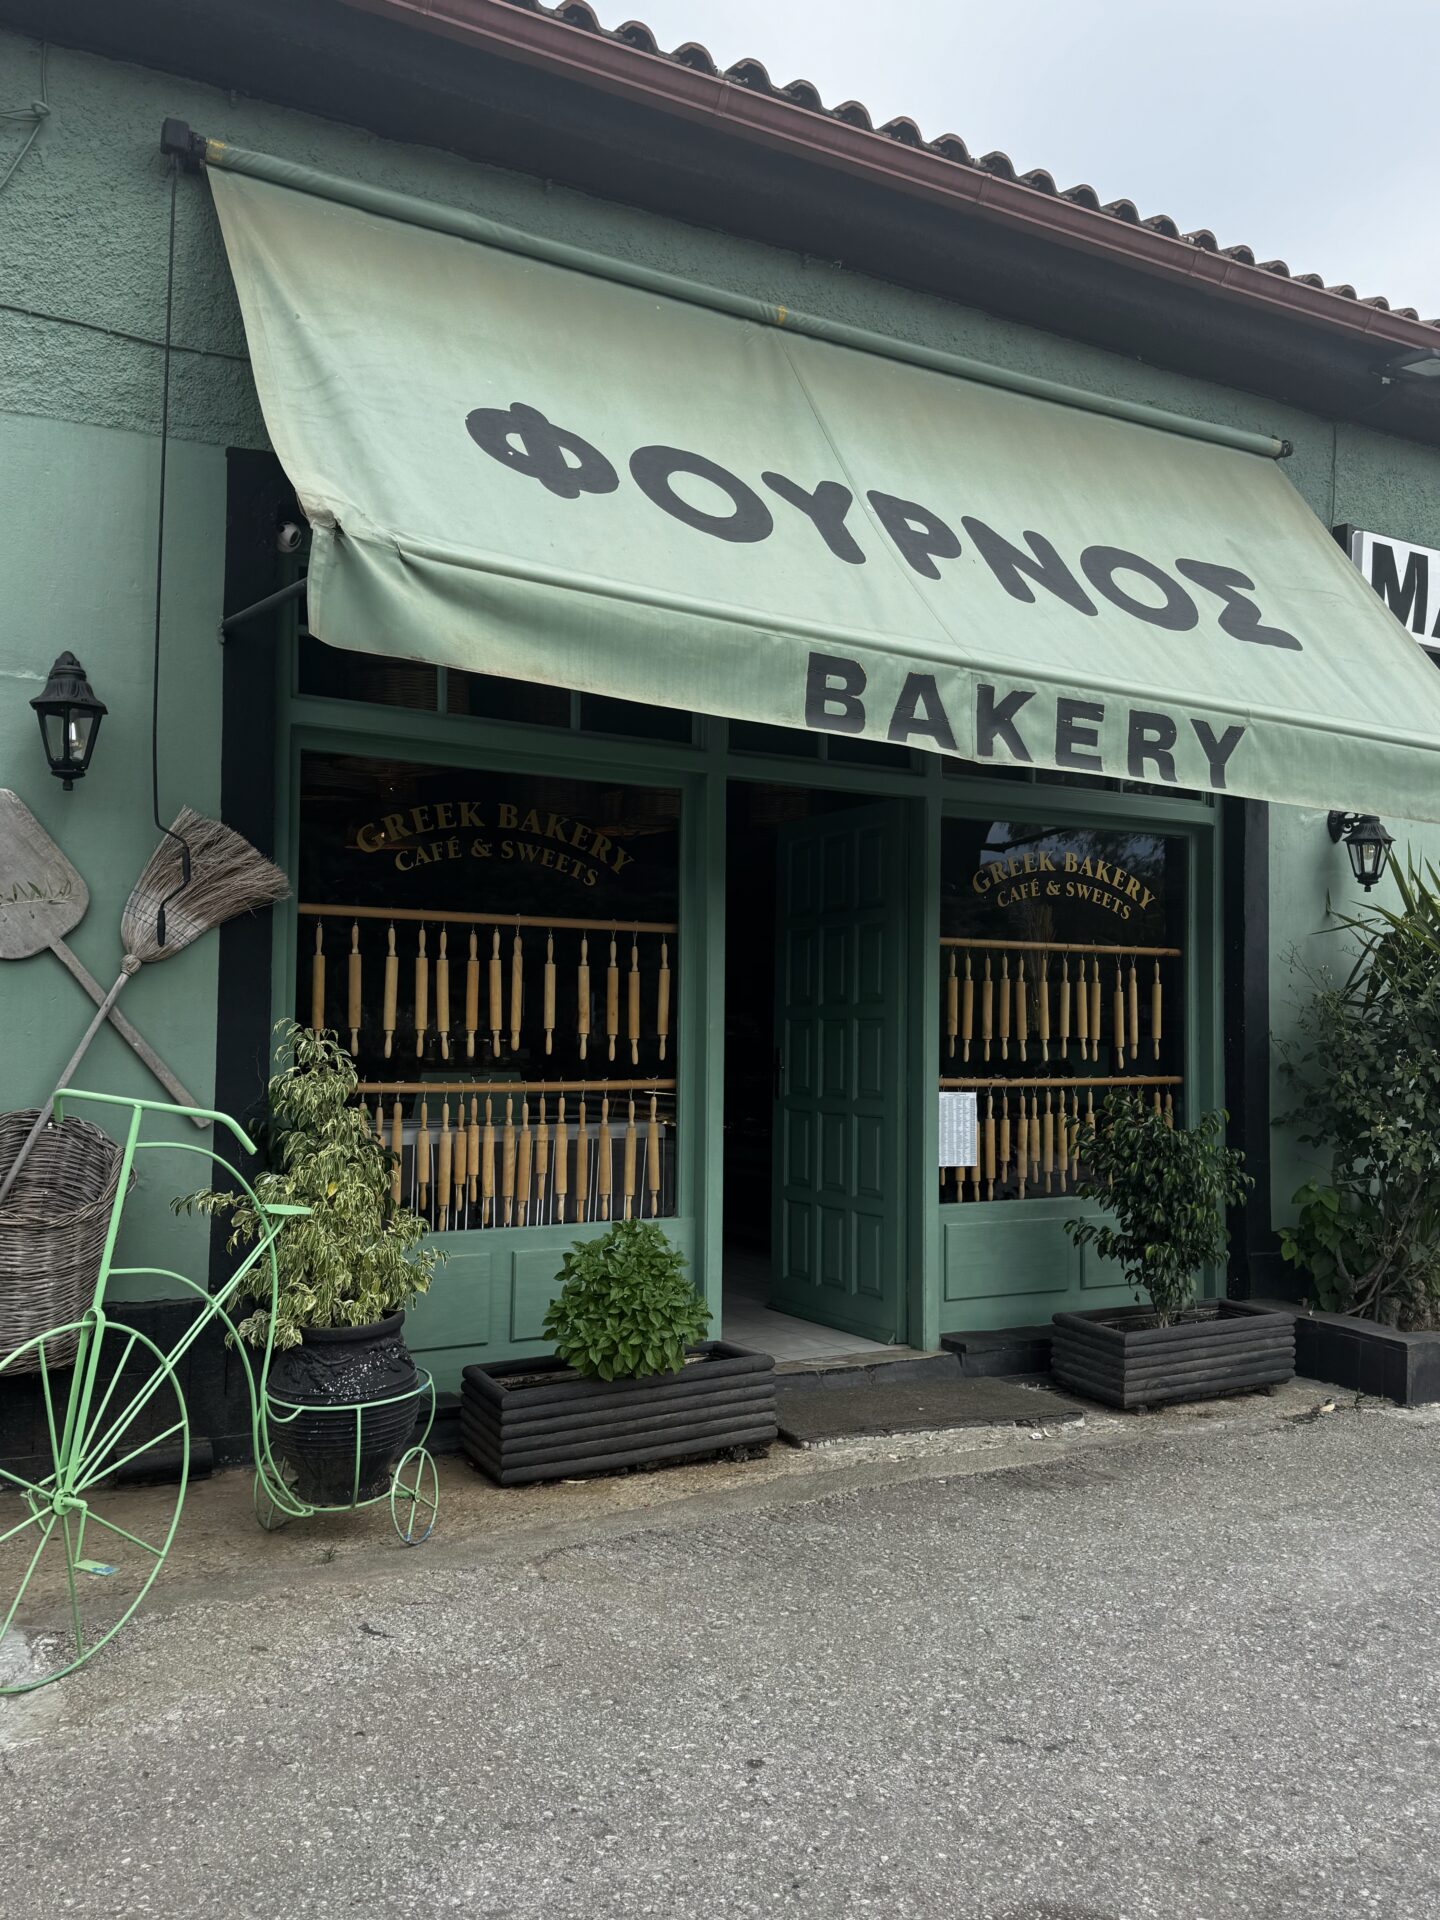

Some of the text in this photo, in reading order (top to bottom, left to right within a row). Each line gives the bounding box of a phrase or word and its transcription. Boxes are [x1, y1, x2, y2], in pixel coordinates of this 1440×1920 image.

[466, 402, 1303, 651] ΦΟΥΡΝΟΣ
[1371, 541, 1440, 639] M
[805, 652, 1245, 788] BAKERY
[356, 801, 635, 875] GREEK BAKERY
[394, 836, 599, 887] CAFÉ & SWEETS
[972, 851, 1158, 911] GREEK BAKERY
[997, 878, 1132, 920] CAFÉ & SWEETS
